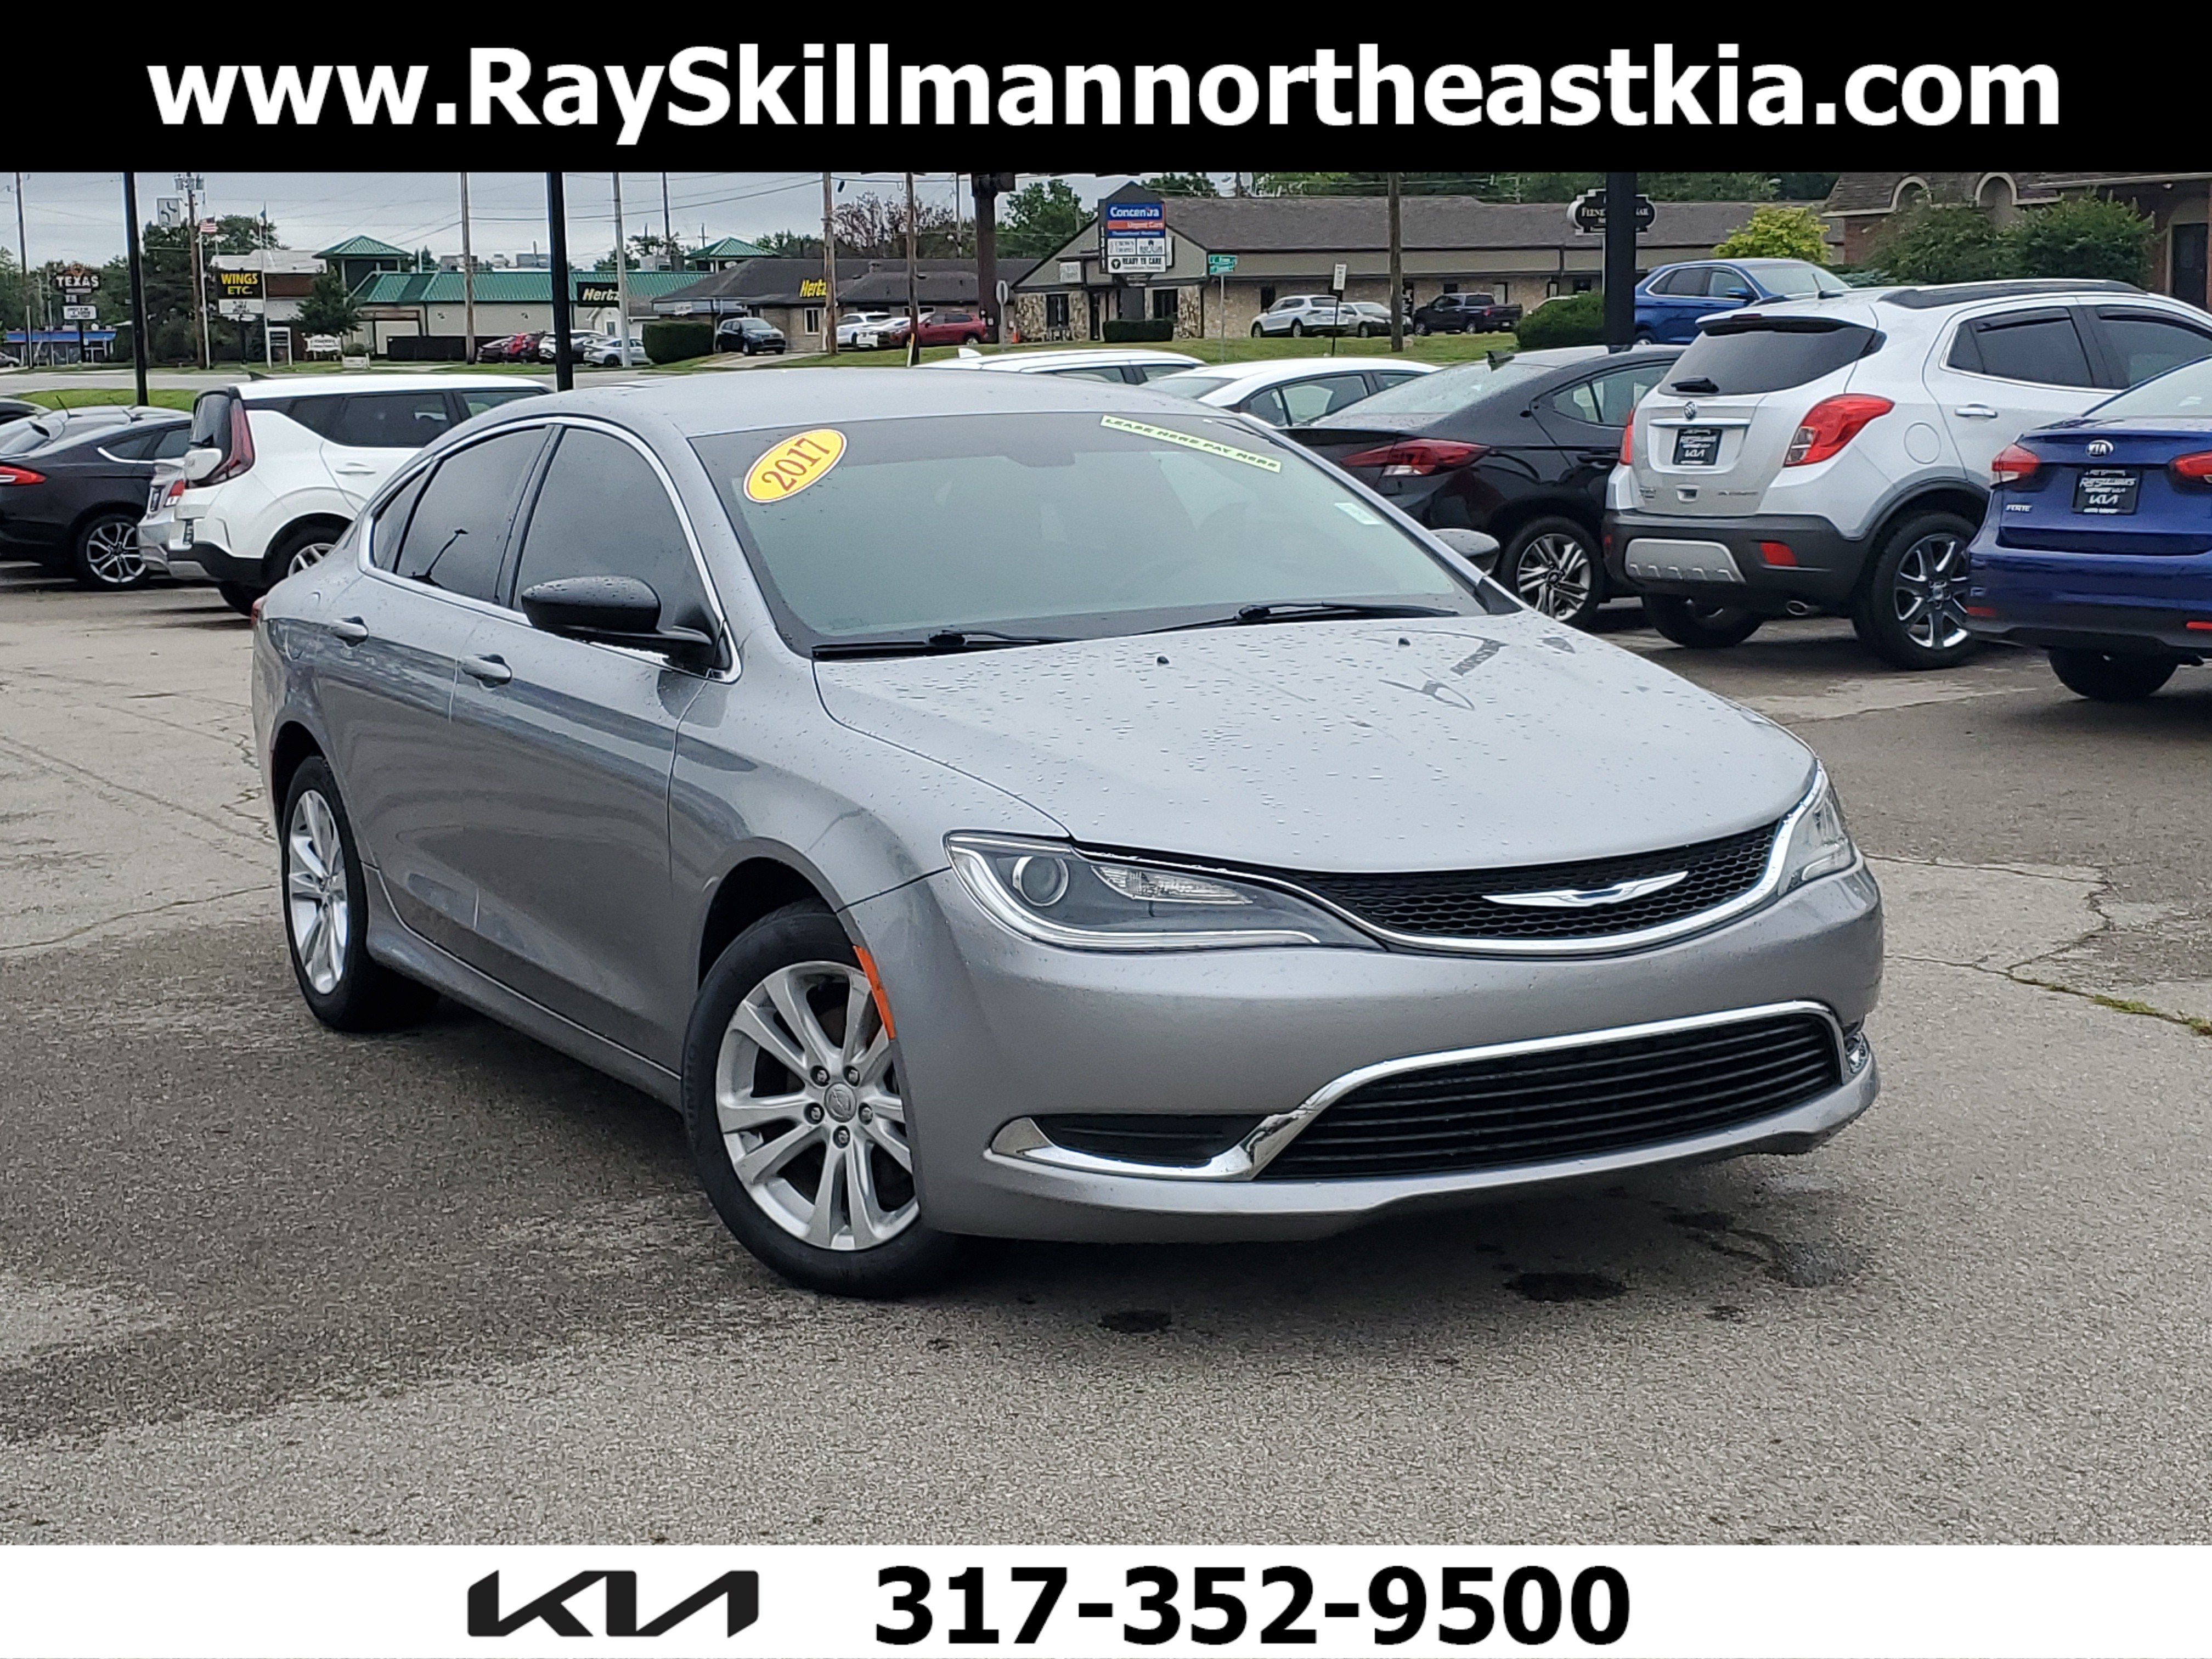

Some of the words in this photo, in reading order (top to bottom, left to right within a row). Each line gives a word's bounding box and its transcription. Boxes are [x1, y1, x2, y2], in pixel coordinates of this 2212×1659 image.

[55, 275, 99, 287] TEXAS
[221, 273, 258, 285] WINGS
[761, 437, 831, 492] 2017
